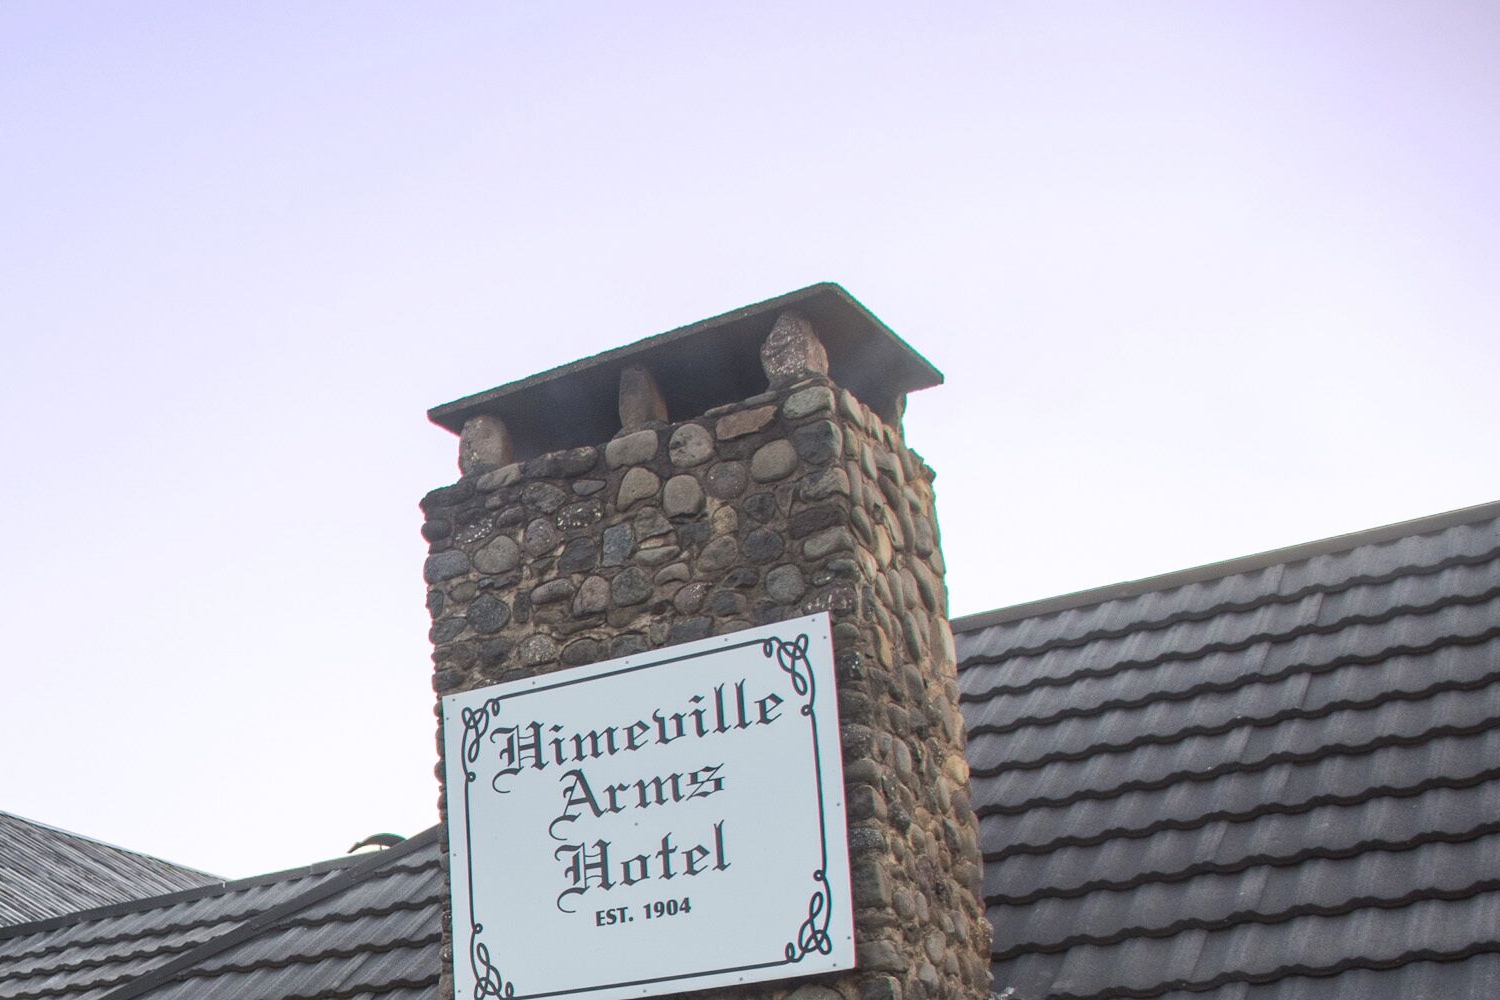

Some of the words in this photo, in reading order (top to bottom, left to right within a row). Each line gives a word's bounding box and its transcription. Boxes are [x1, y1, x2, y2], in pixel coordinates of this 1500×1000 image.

[490, 678, 784, 793] Himeville
[549, 763, 725, 841] Arms
[554, 819, 731, 913] Hotel
[596, 907, 634, 927] EST.
[644, 897, 692, 920] 1904
